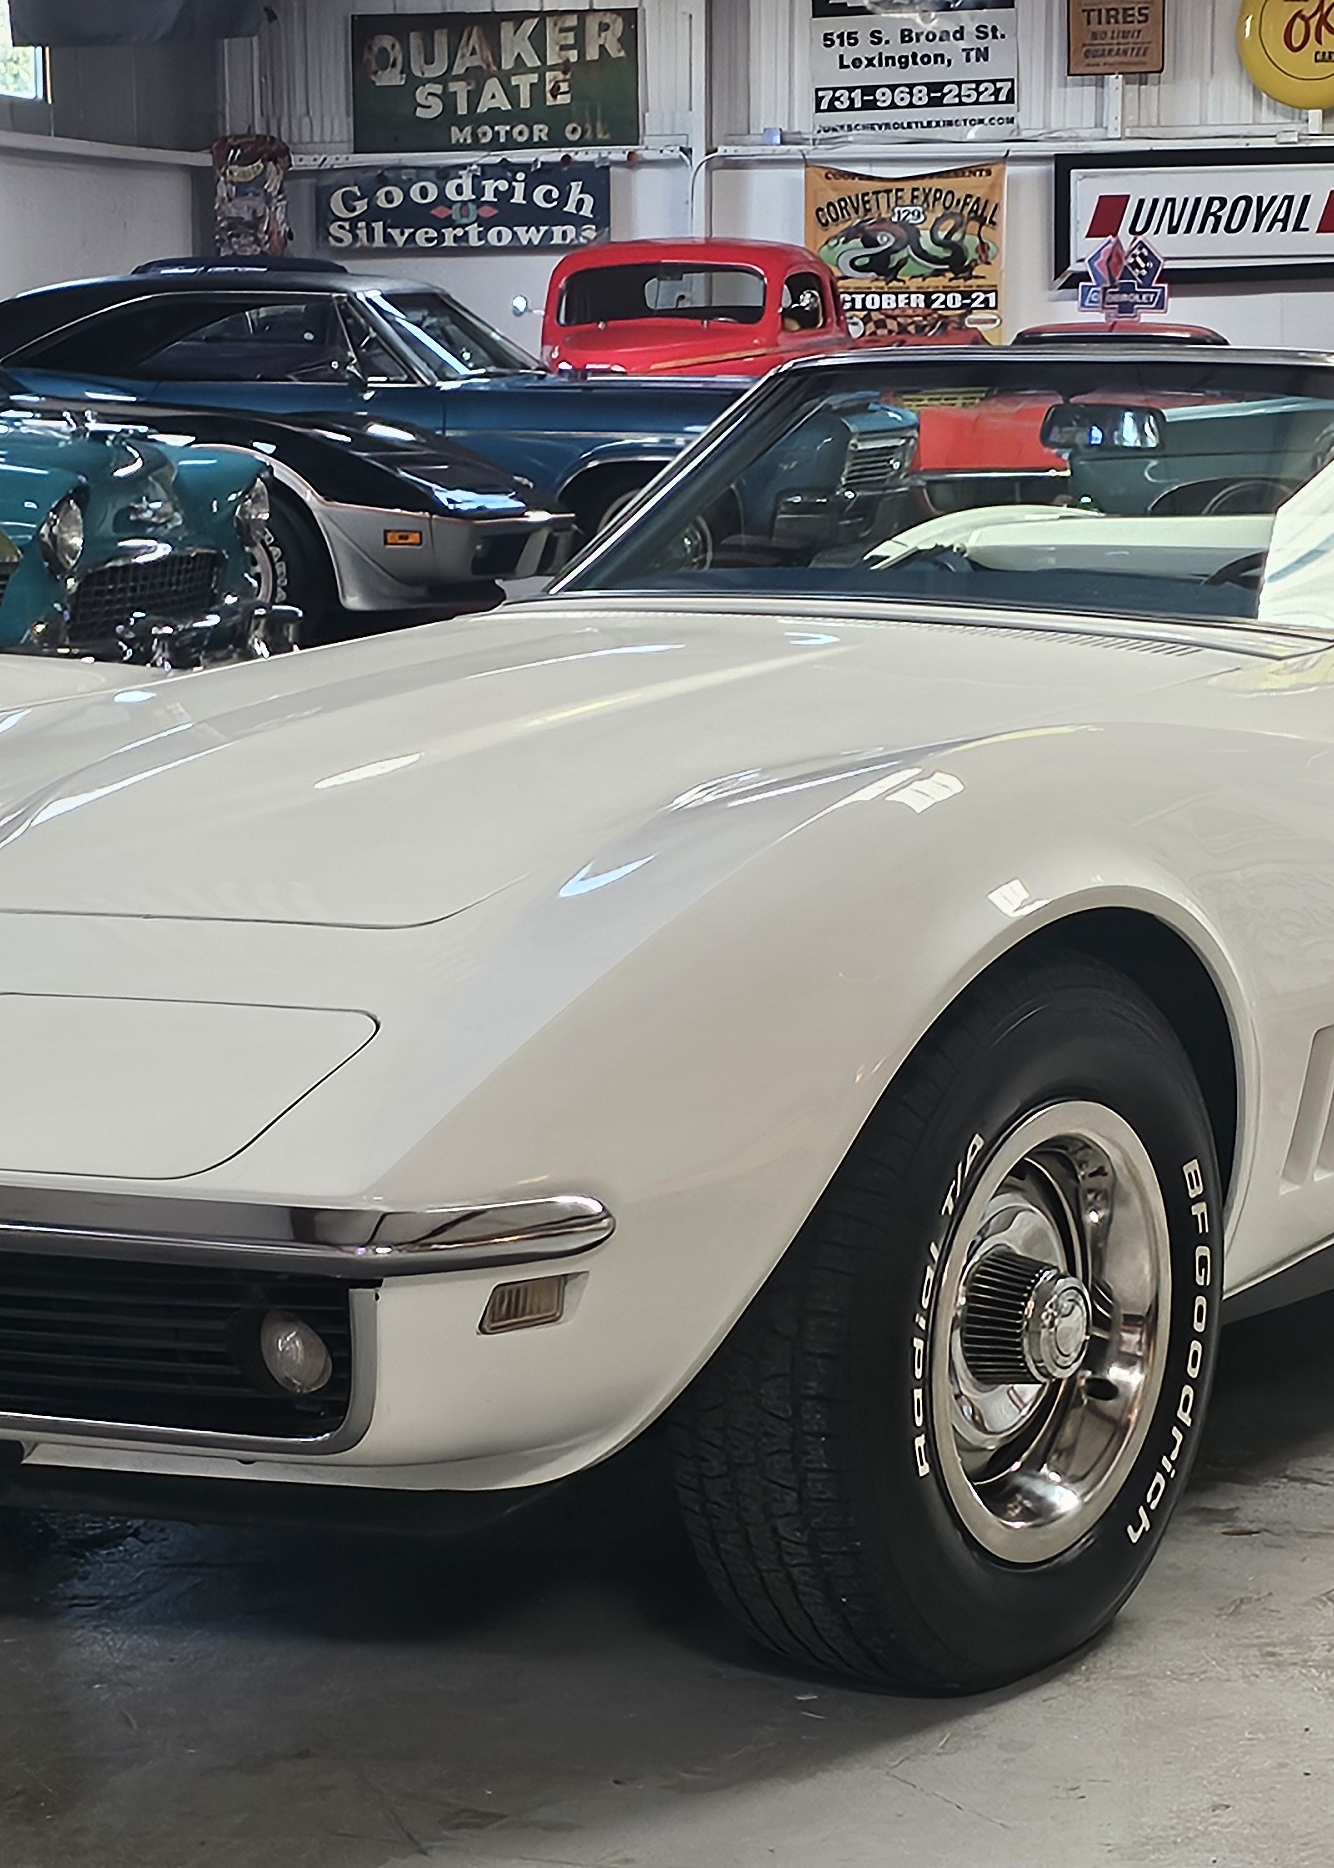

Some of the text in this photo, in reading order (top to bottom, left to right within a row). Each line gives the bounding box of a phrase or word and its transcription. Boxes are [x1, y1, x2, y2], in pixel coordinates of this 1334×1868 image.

[1082, 7, 1149, 25] TIRES
[363, 12, 627, 86] QUAKER
[823, 24, 1006, 48] 515 S. Broad St.
[838, 46, 990, 69] Lexington, TN
[416, 71, 571, 119] STATE
[817, 81, 1012, 110] 731-968-2527
[451, 120, 610, 145] MOTOR OIL
[330, 169, 597, 218] Goodrich
[815, 188, 905, 228] CORVETTE
[1128, 194, 1312, 236] UNIROYAL
[328, 221, 597, 248] Silvertowns
[840, 292, 997, 310] CTOBER 20-21
[913, 1133, 985, 1477] Radial T/A
[1127, 1158, 1211, 1544] BFGoodrich
